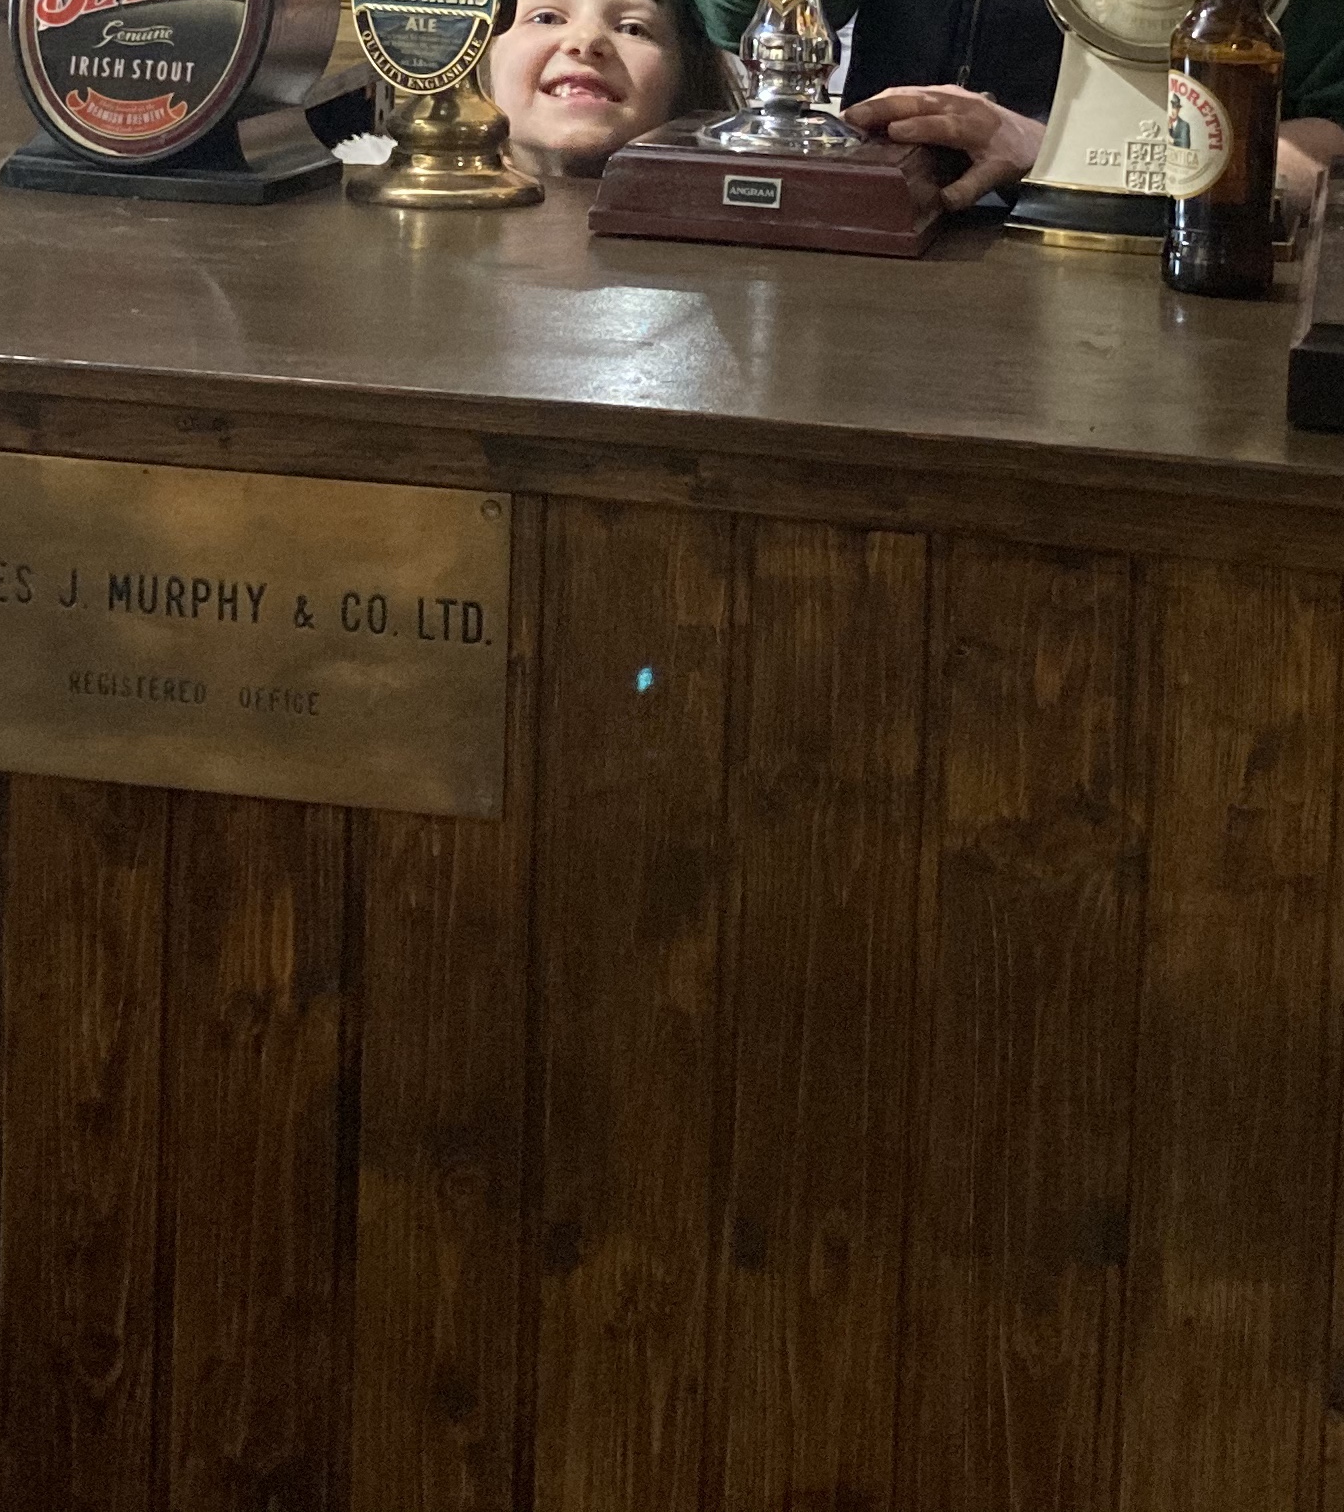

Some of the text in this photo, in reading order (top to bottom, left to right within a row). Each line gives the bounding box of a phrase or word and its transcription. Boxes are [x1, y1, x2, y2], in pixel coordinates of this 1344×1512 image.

[93, 20, 175, 48] Genuine
[406, 16, 438, 32] ALE
[70, 55, 196, 83] IRISH STOUT
[362, 30, 403, 84] QUALITY
[407, 64, 464, 91] ENGLISH
[464, 37, 483, 68] ALE
[1170, 78, 1223, 151] MORETTI
[729, 186, 775, 198] ANGRAM
[107, 572, 269, 625] MURPHY
[293, 594, 316, 631] &
[340, 591, 399, 637] CO.
[417, 595, 494, 648] LTD.
[67, 669, 322, 717] REGISTERED OFFICE
